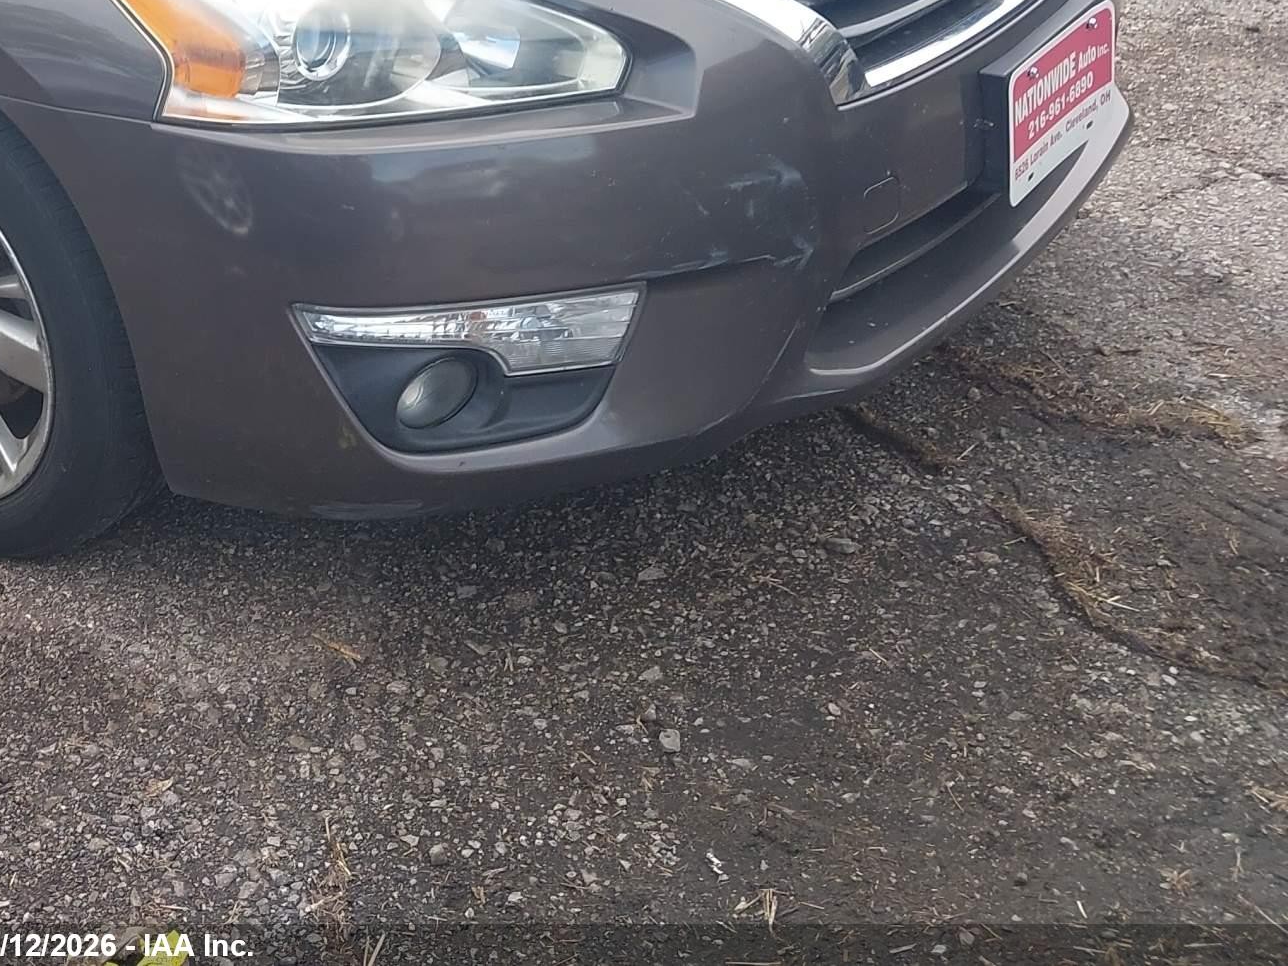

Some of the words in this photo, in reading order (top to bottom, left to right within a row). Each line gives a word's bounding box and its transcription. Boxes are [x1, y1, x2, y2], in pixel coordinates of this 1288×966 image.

[1014, 51, 1076, 127] NATIONWIDE
[1078, 44, 1096, 73] Auto
[1097, 43, 1110, 58] Inc.
[1027, 70, 1094, 140] 216-961-6890
[1100, 88, 1111, 106] OH
